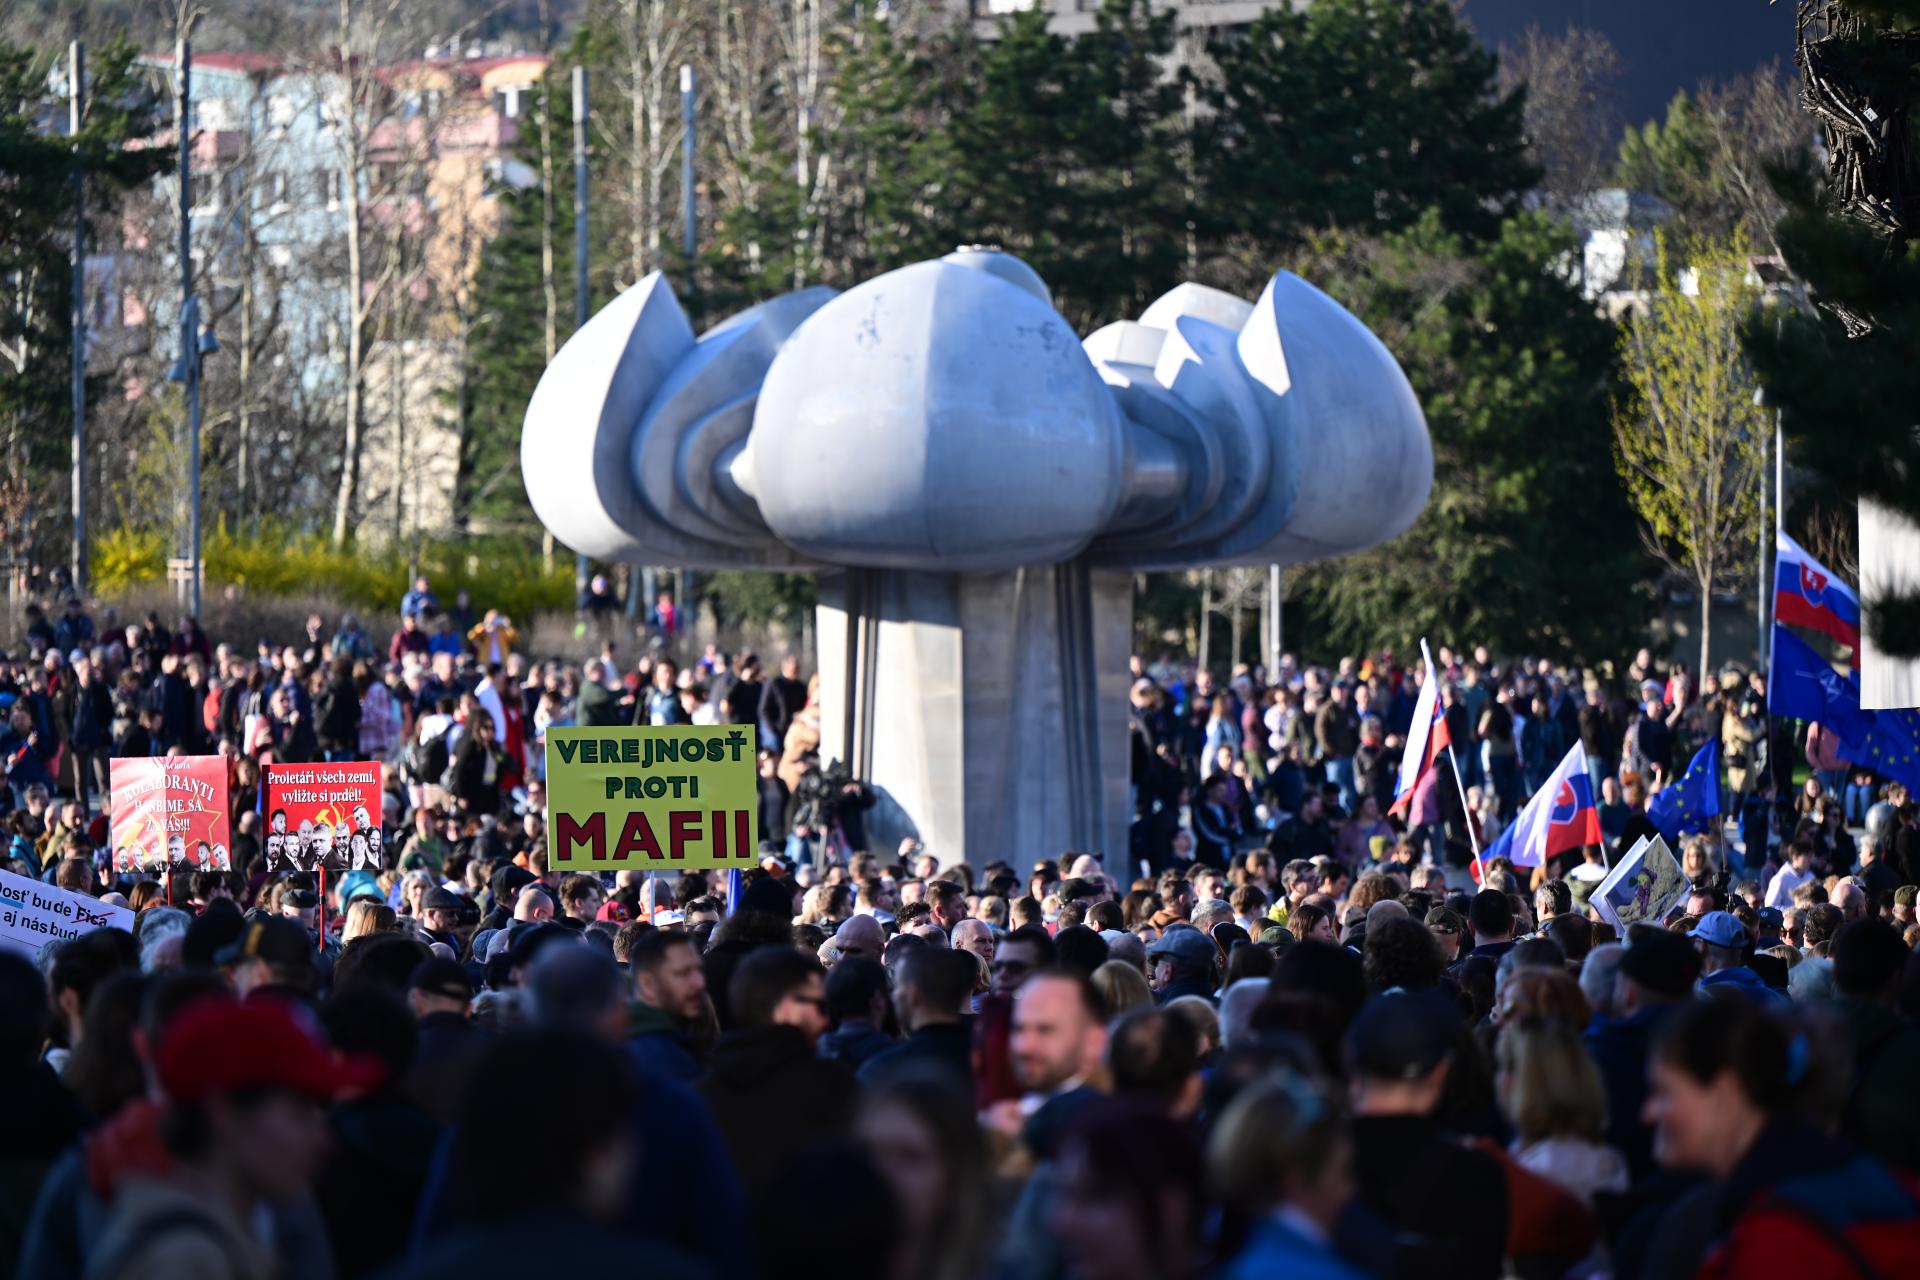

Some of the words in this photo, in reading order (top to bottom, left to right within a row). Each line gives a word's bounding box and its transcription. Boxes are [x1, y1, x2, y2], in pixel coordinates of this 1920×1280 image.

[555, 731, 747, 768] VEREJNOSŤ
[268, 771, 314, 784] Proletáři
[316, 771, 346, 784] všech
[348, 769, 376, 785] zemí,
[605, 776, 698, 799] PROTI
[123, 774, 215, 804] KOLABORANTI
[282, 789, 317, 805] vyližte
[319, 789, 328, 802] si
[187, 799, 203, 812] SA
[160, 815, 190, 832] VÁS!!!
[556, 810, 750, 861] MAFII
[32, 893, 72, 917] bude
[76, 907, 107, 927] Fica
[3, 911, 17, 928] aj
[21, 916, 48, 934] nás
